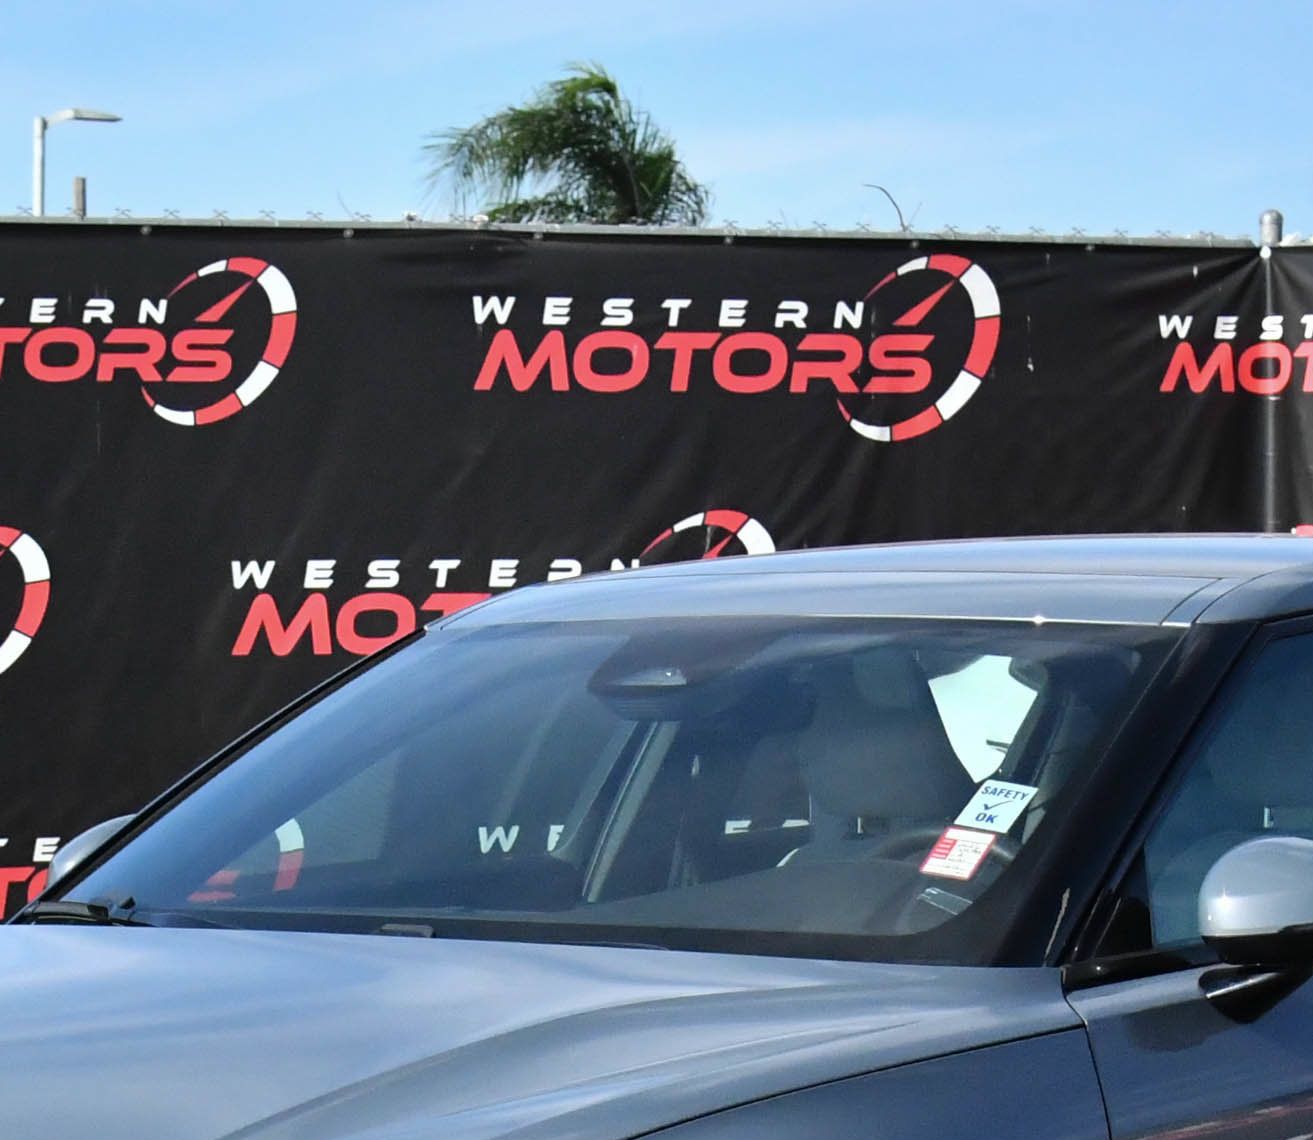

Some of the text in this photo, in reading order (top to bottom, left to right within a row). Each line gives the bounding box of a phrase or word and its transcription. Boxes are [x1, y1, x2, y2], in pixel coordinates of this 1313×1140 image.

[473, 296, 864, 328] WESTERN
[474, 329, 934, 393] MOTORS
[982, 786, 1029, 801] SAFETY
[975, 813, 998, 824] OK
